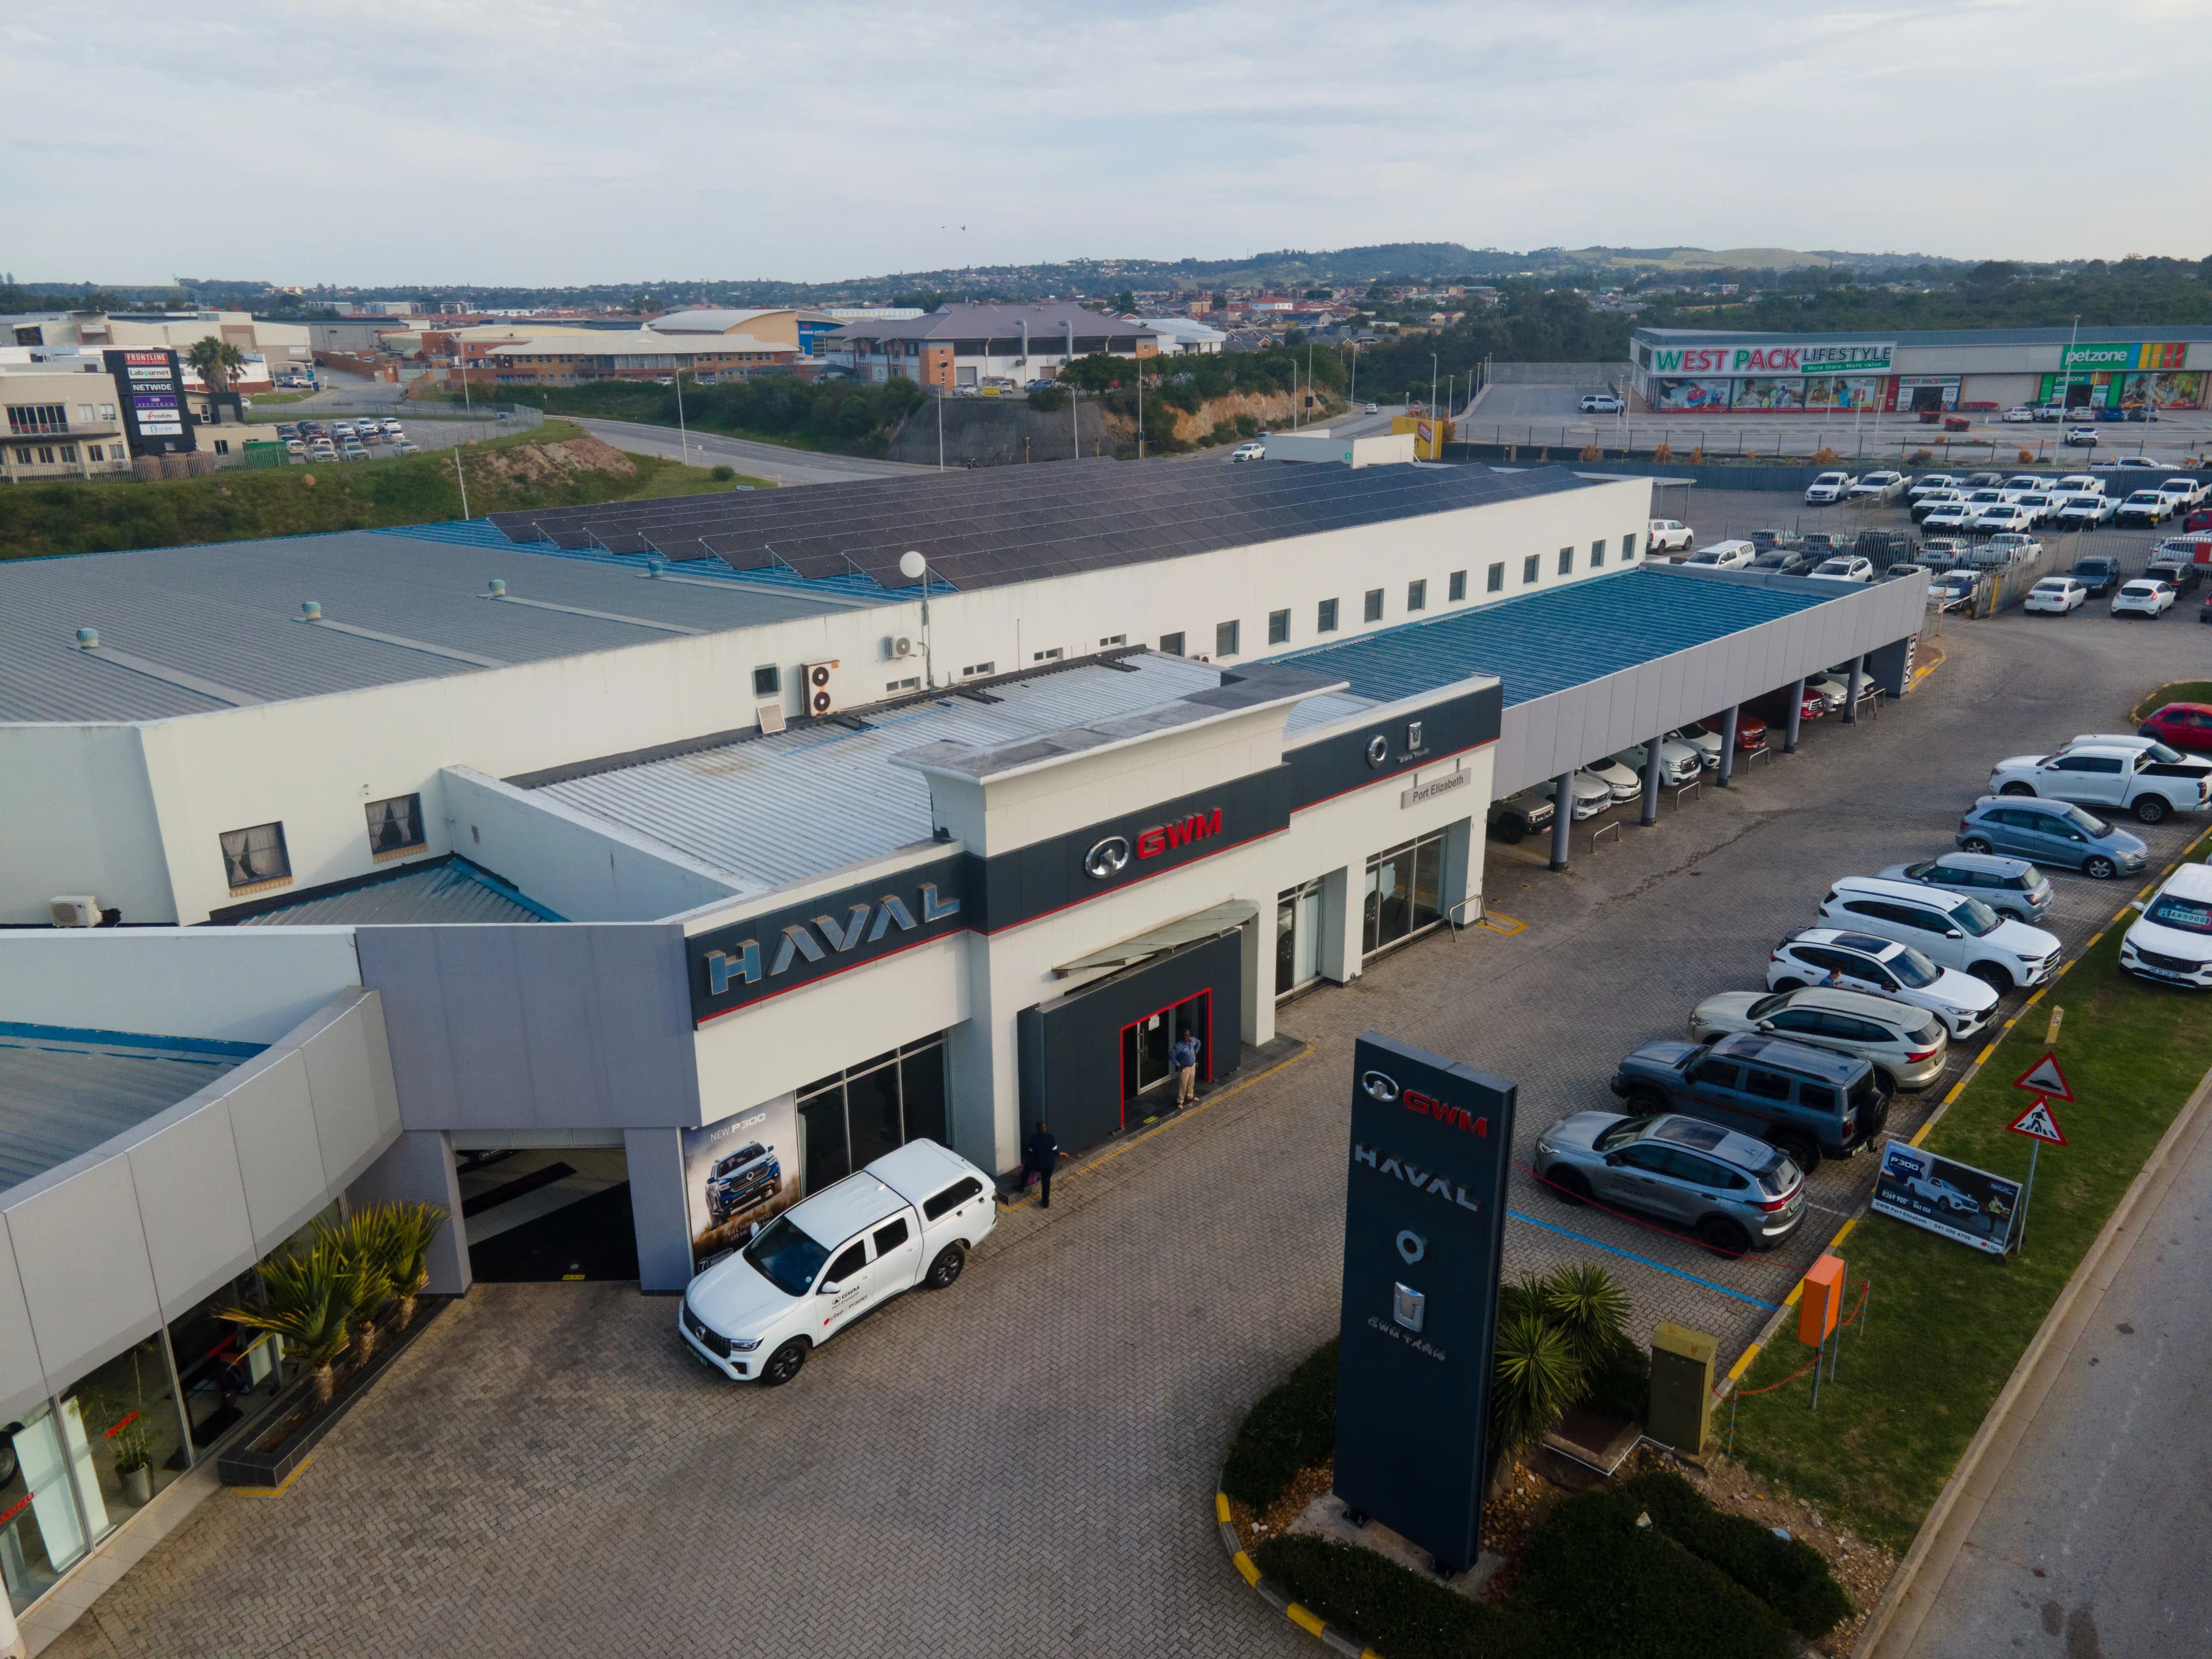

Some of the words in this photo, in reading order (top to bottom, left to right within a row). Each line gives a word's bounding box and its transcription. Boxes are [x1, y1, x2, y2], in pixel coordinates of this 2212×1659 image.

[1656, 349, 1729, 371] WEST
[1734, 348, 1801, 371] PACK
[1802, 347, 1892, 361] LIFESTYLE
[2065, 349, 2127, 365] petzone
[2056, 374, 2085, 383] pezone
[1904, 641, 1915, 683] PARTS
[1399, 755, 1412, 763] GWM
[1412, 787, 1429, 802] Port
[1431, 775, 1464, 796] Elizabeth
[1137, 808, 1222, 859] GWM
[707, 883, 960, 995] HAVAL
[1404, 1089, 1487, 1137] GWM
[710, 1127, 730, 1142] NEW
[732, 1112, 766, 1133] P300
[1890, 1156, 1919, 1171] P300
[1355, 1143, 1478, 1212] HAVAL
[1881, 1190, 1896, 1200] R369
[757, 1211, 774, 1222] DIESEL
[1876, 1202, 1889, 1210] GWM
[1890, 1207, 1902, 1215] Port
[1903, 1212, 1927, 1224] Elizabeth
[842, 1286, 859, 1299] GWM
[1368, 1316, 1399, 1339] GWM
[104, 1409, 139, 1439] ISUZU
[0, 1491, 34, 1524] ISUZU
